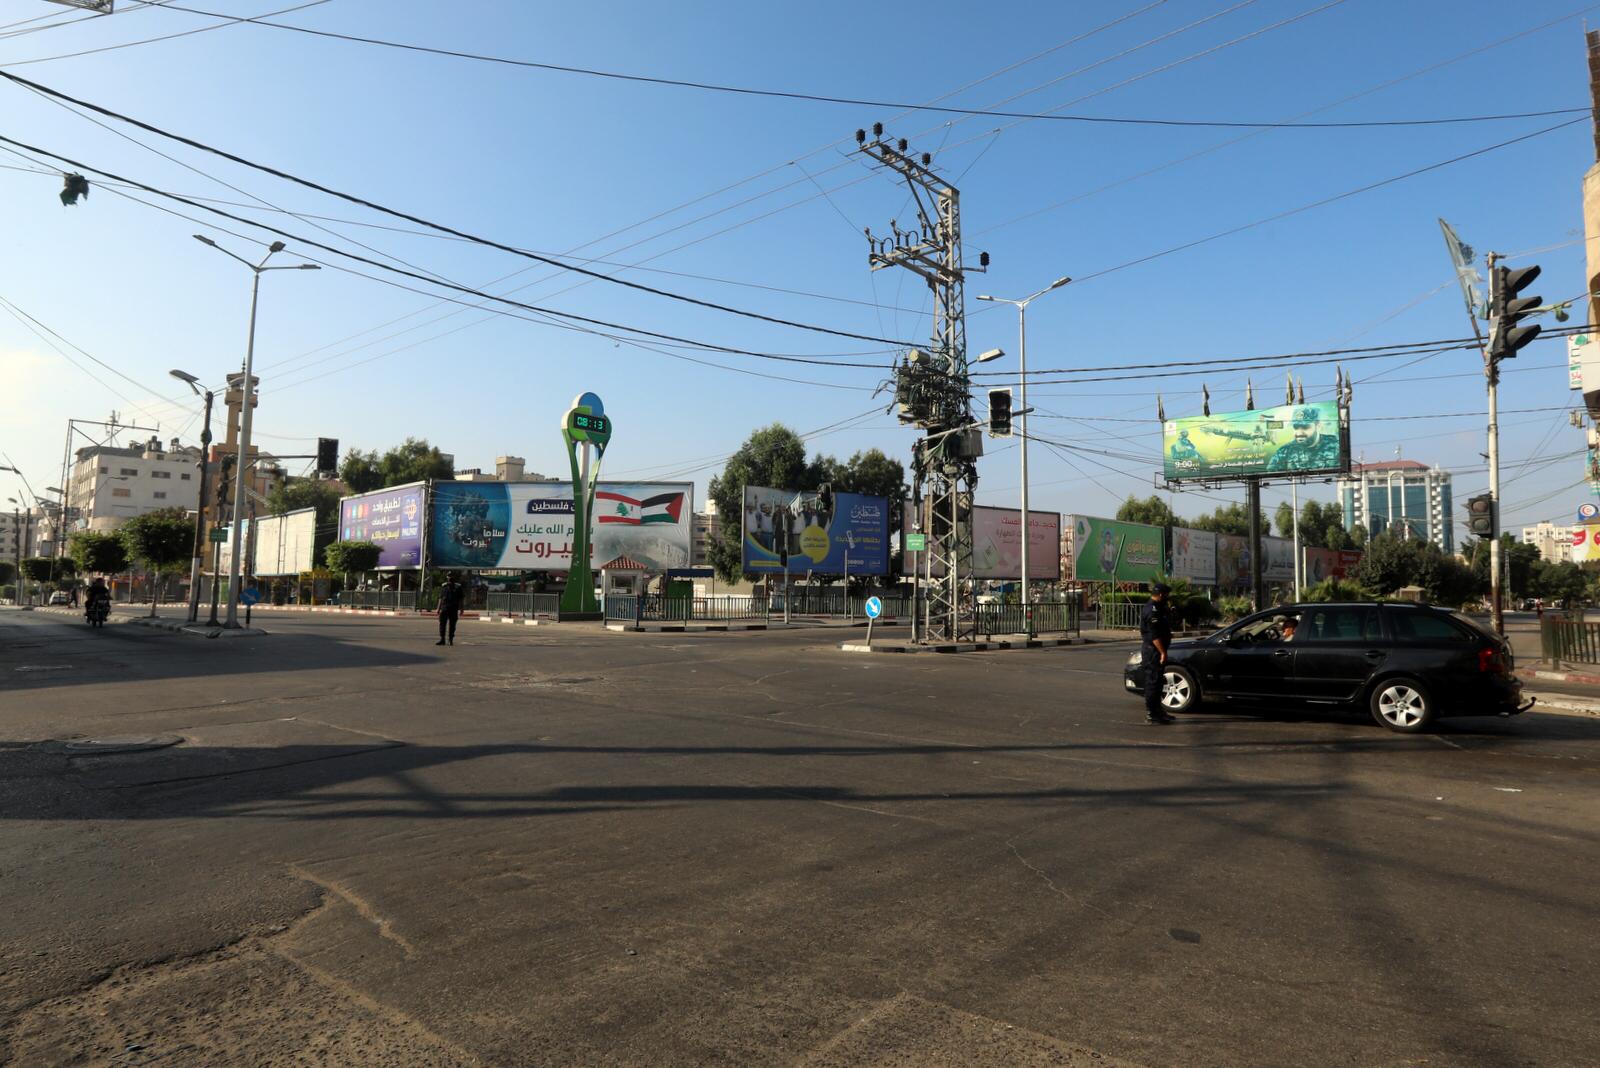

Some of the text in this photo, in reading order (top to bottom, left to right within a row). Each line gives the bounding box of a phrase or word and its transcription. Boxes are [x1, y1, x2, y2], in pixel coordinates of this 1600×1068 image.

[577, 417, 603, 429] 08:13
[531, 501, 569, 511] فلسطين
[516, 523, 544, 536] عليك
[546, 524, 564, 535] الله
